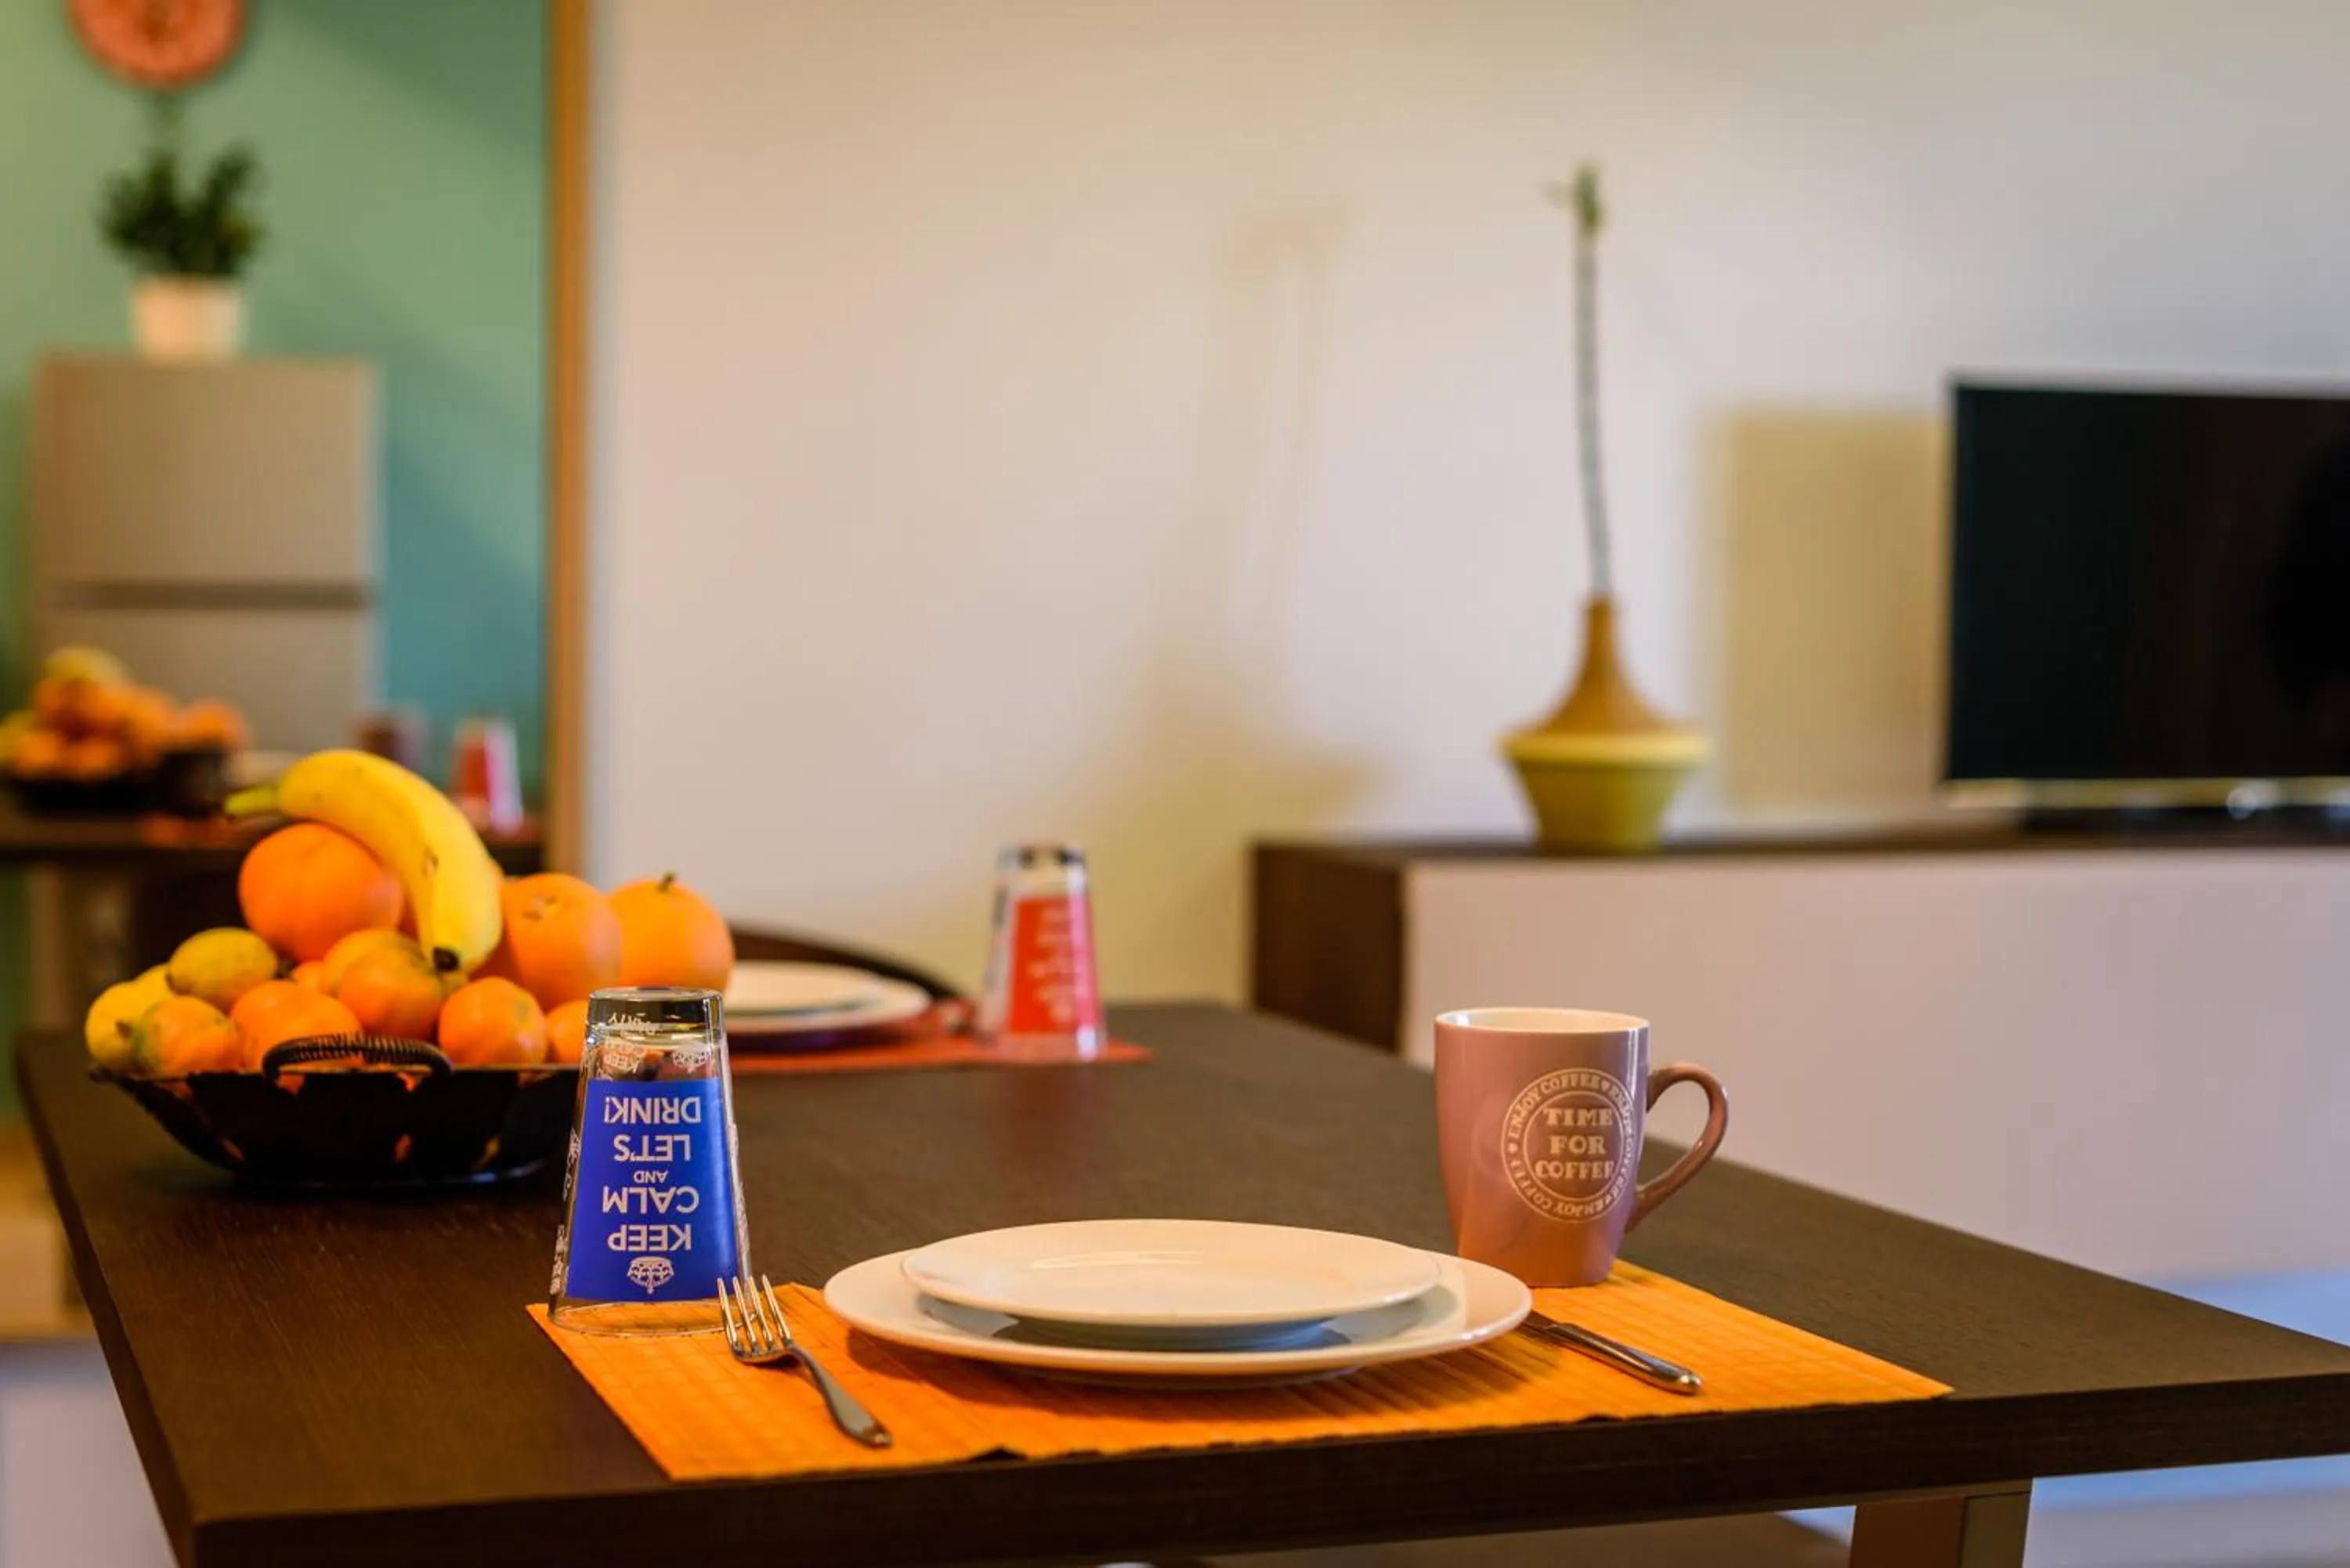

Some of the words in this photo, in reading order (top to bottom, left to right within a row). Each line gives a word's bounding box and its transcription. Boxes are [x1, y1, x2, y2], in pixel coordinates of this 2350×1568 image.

[603, 1097, 702, 1124] DRINK!
[1508, 1086, 1542, 1139] ENJOY
[1540, 1073, 1600, 1093] COFFEE
[1542, 1107, 1613, 1126] TIME
[1549, 1136, 1607, 1155] FOR
[633, 1169, 668, 1183] AND
[1534, 1160, 1614, 1179] COFFEE
[602, 1185, 700, 1214] CALM
[606, 1224, 692, 1252] KEEP
